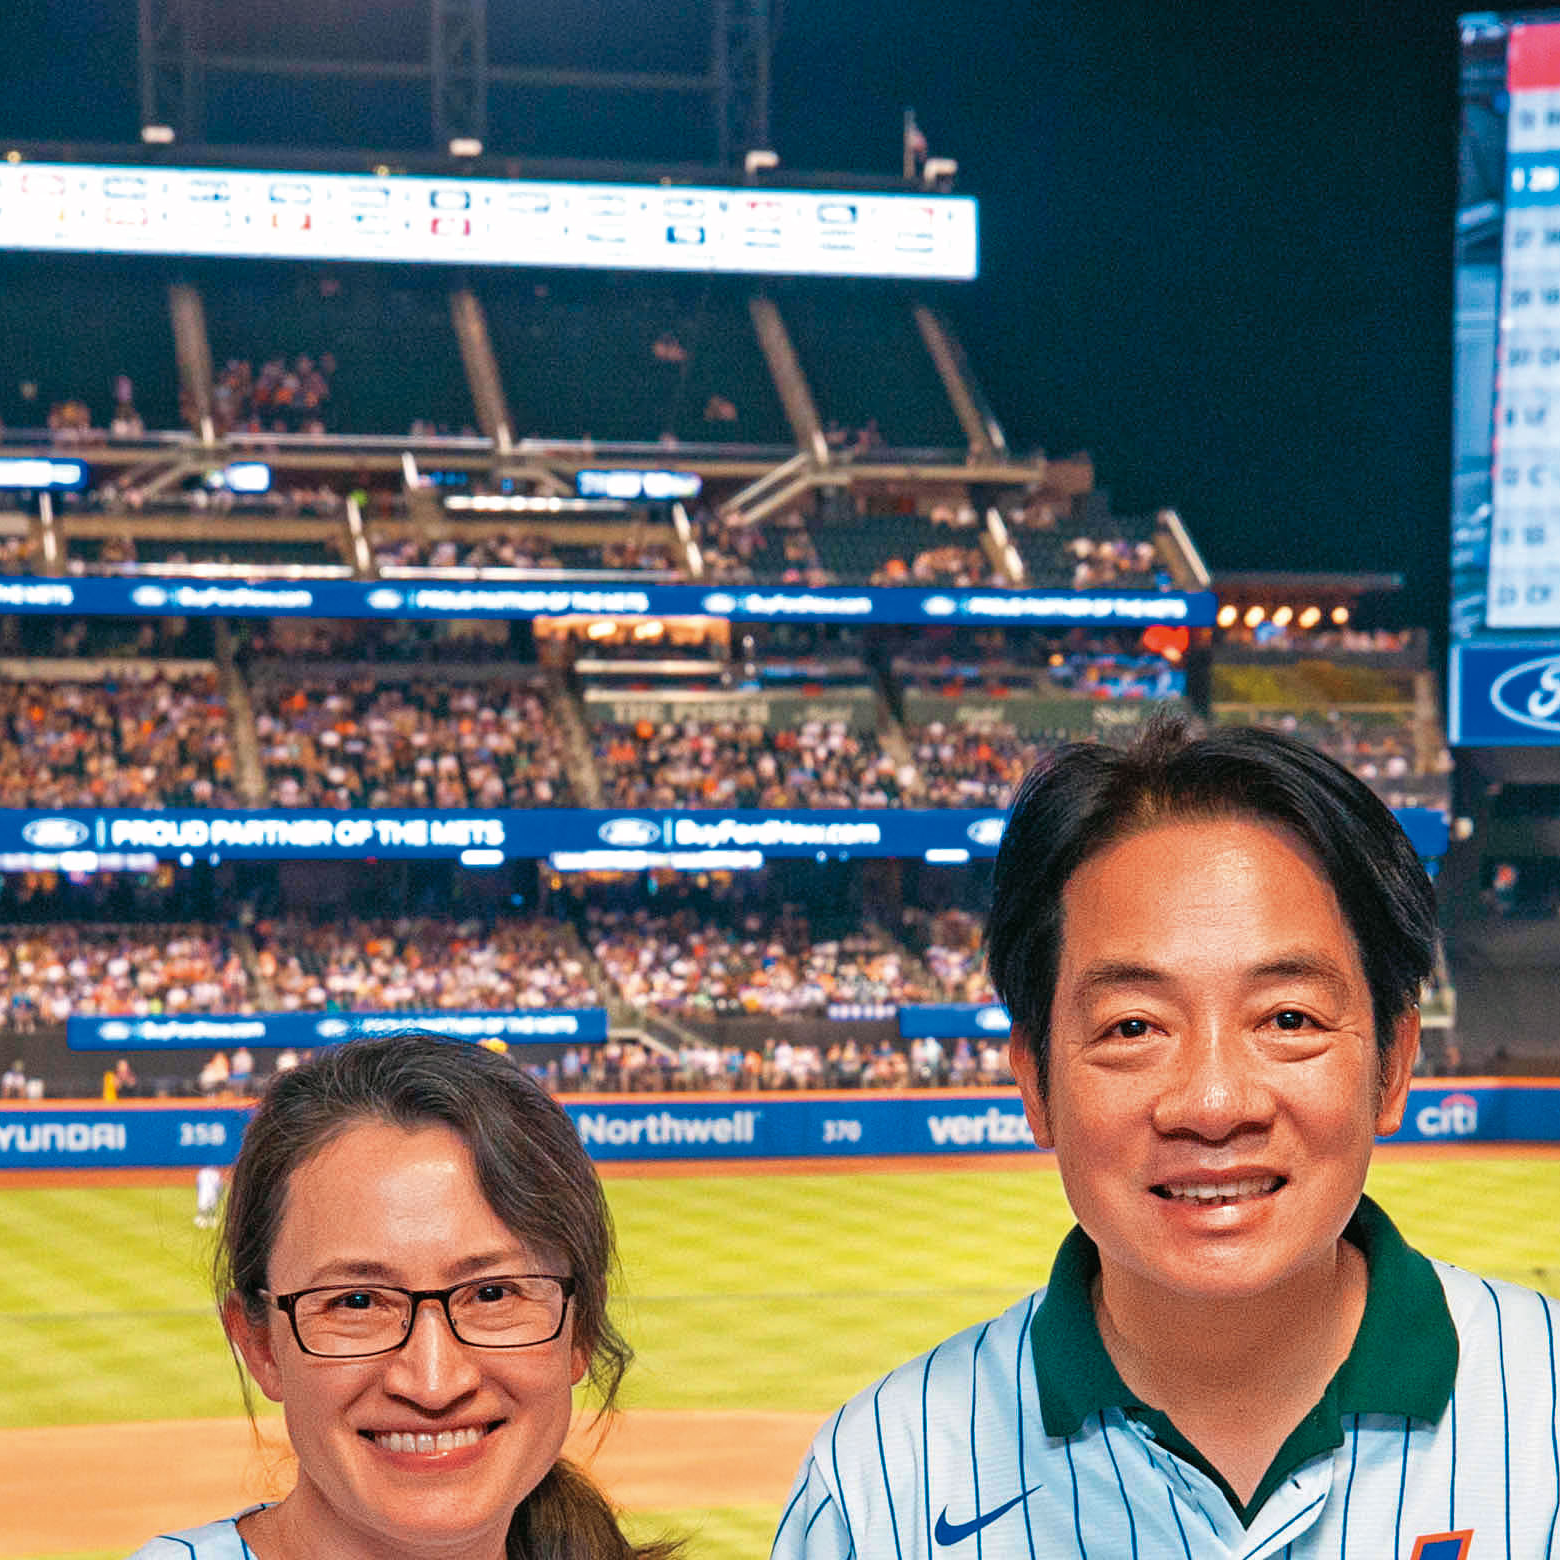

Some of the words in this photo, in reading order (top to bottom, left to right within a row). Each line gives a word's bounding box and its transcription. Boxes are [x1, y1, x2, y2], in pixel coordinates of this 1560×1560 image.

[111, 819, 208, 846] PROUD
[210, 819, 334, 846] PARTNER
[334, 819, 374, 846] OF
[376, 819, 429, 846] THE
[430, 819, 505, 846] METS
[578, 1111, 755, 1145] Northwell
[1416, 1097, 1478, 1136] citi
